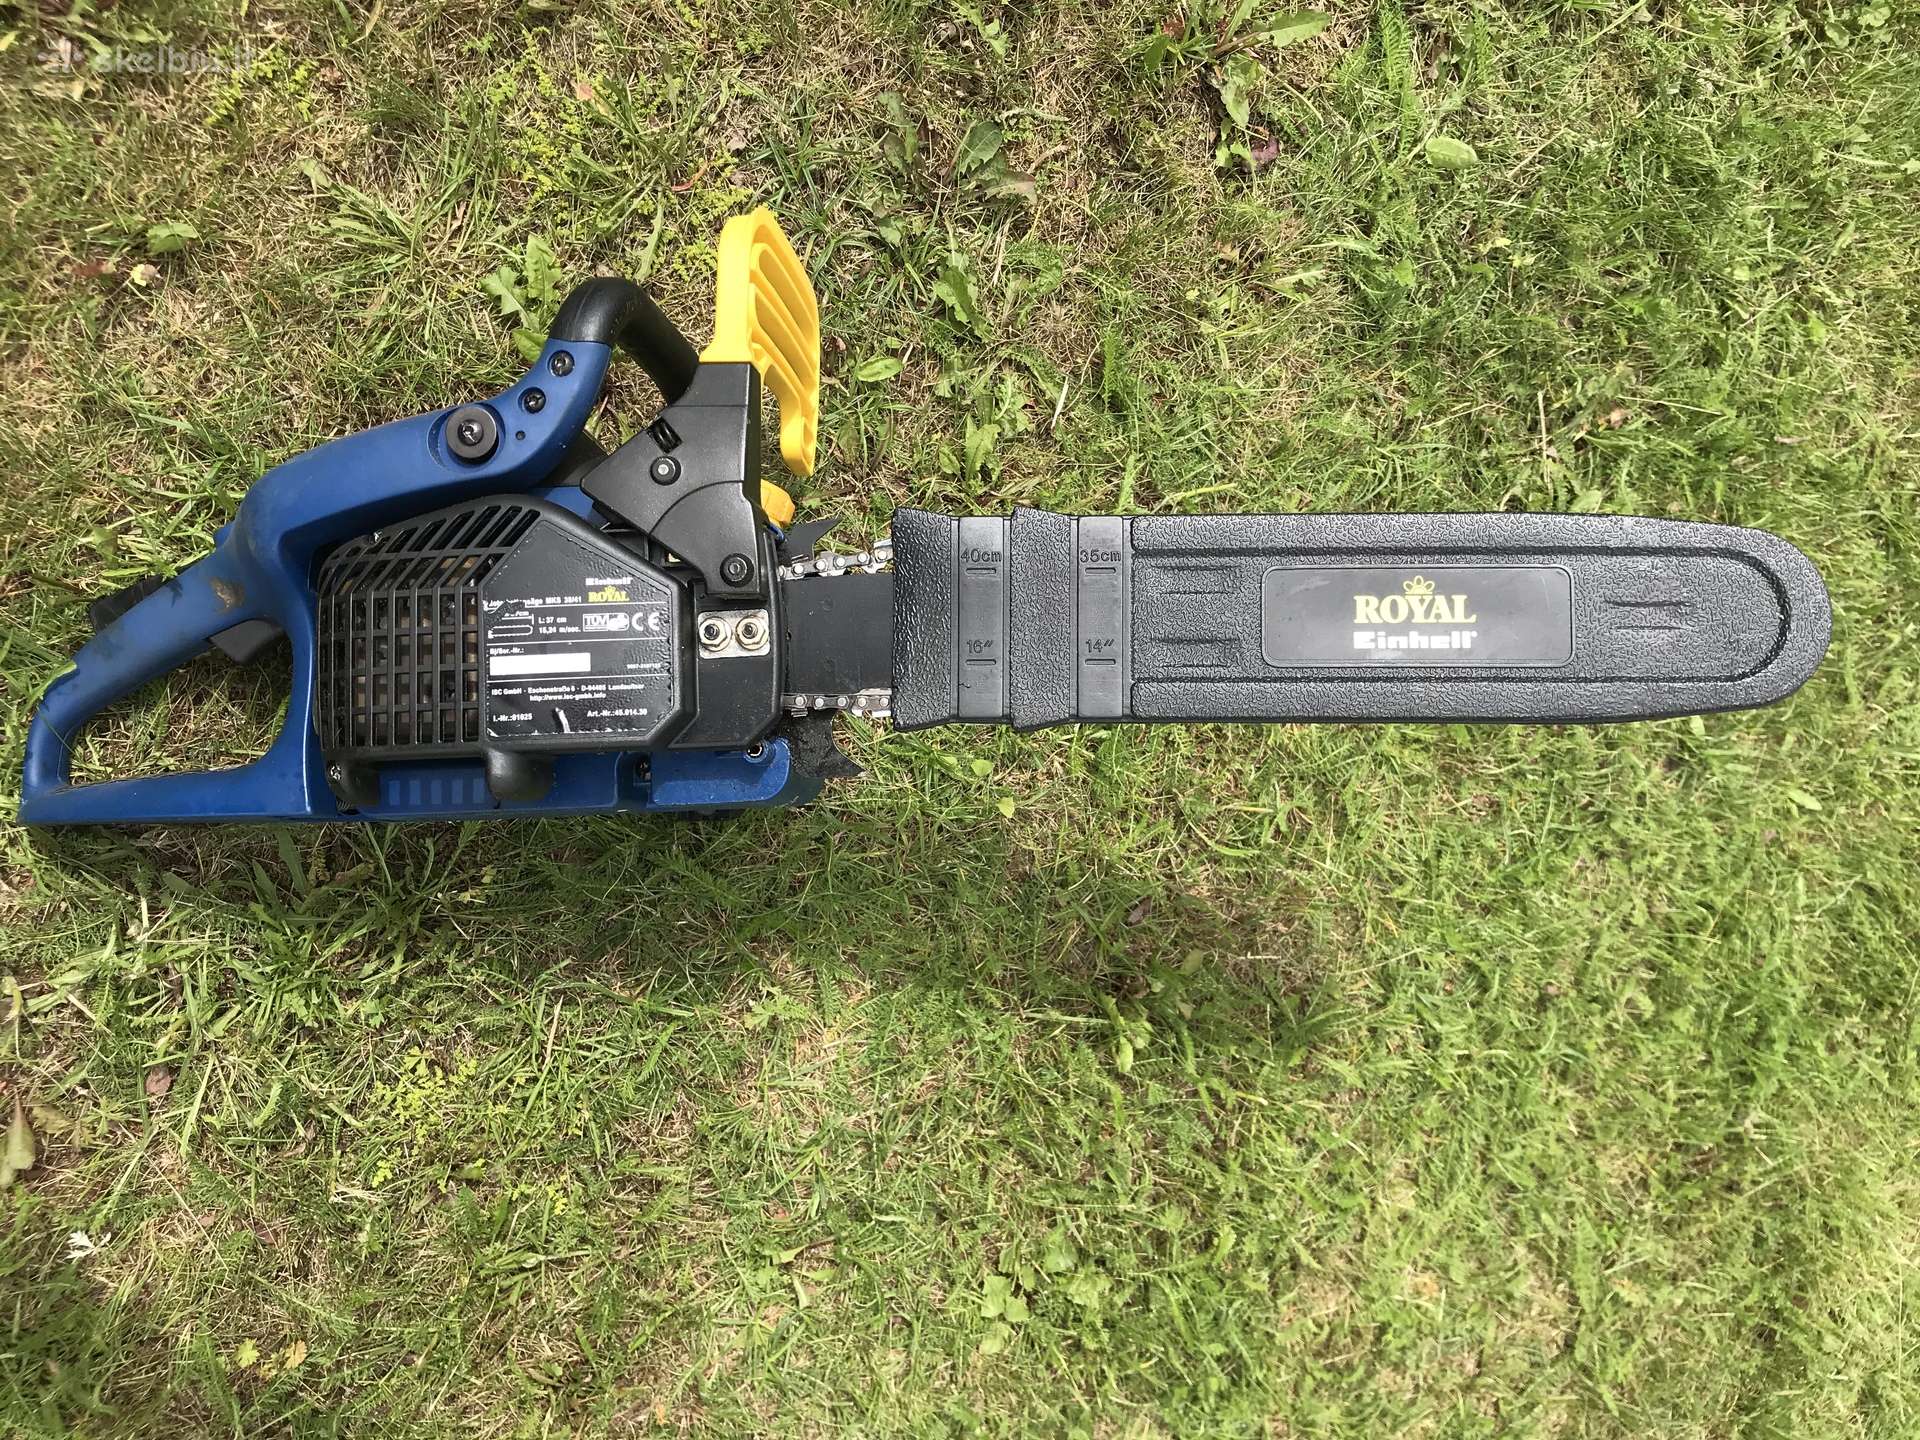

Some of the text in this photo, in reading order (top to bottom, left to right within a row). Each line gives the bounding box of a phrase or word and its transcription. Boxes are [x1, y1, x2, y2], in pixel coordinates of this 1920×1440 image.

[960, 549, 1002, 562] 40cm
[1079, 549, 1121, 562] 35cm
[585, 577, 633, 586] Einhell
[588, 591, 630, 602] ROYAL
[1353, 595, 1477, 624] ROYAL
[1353, 631, 1474, 649] Einhell
